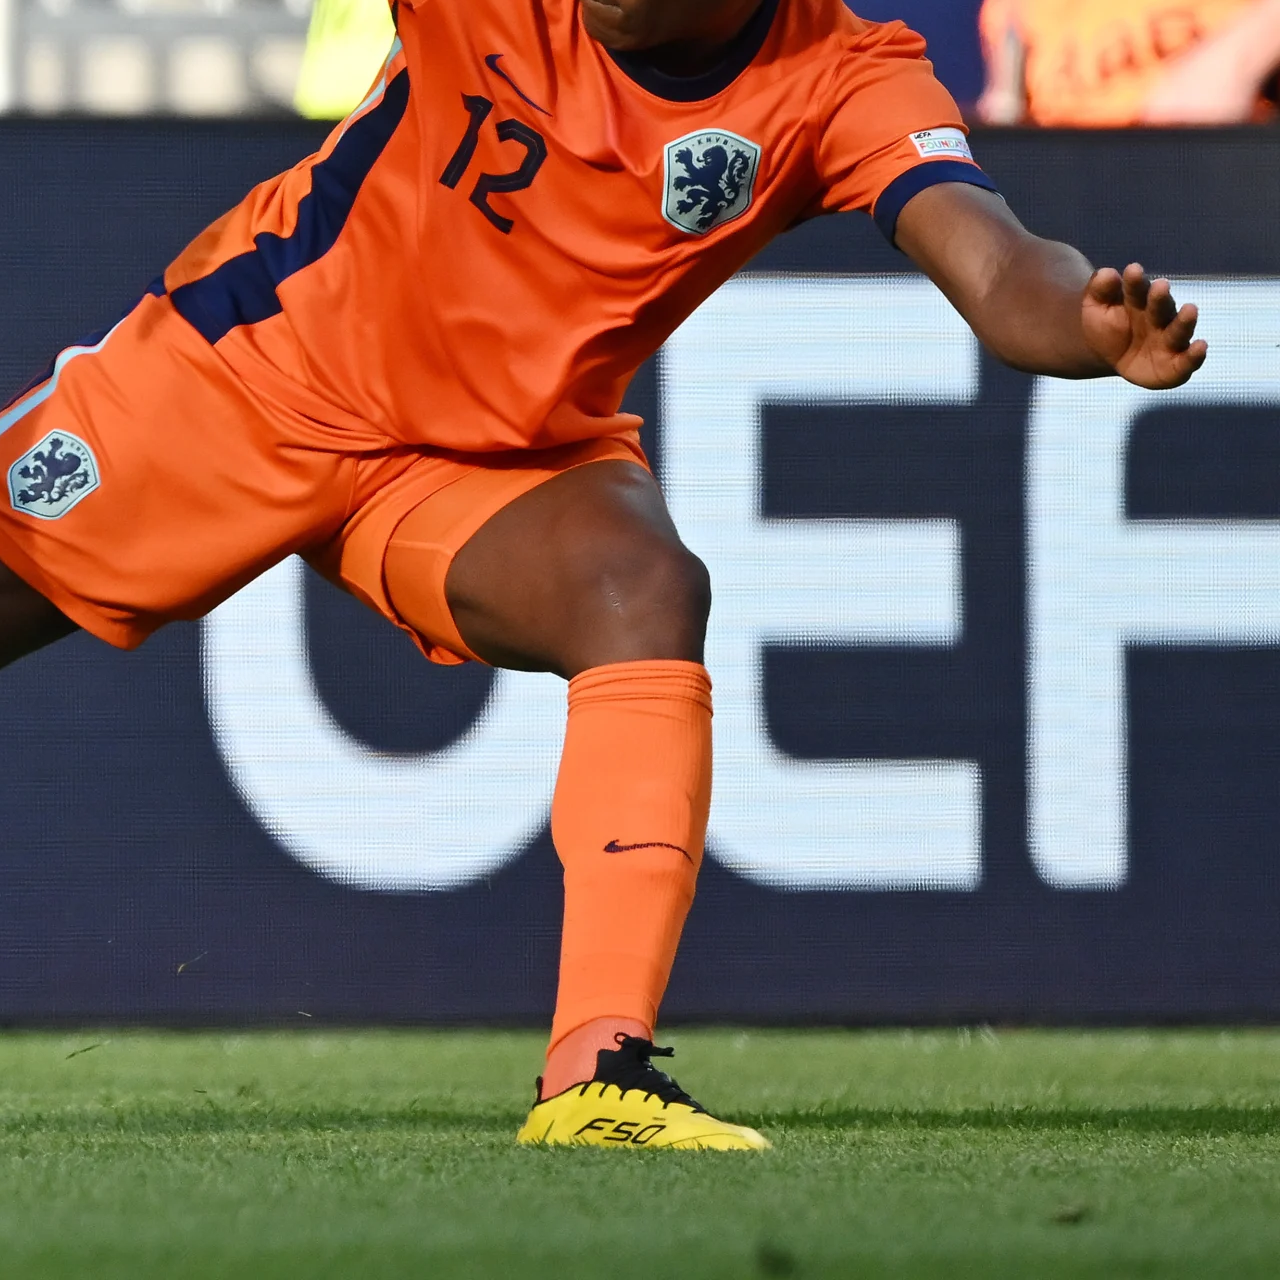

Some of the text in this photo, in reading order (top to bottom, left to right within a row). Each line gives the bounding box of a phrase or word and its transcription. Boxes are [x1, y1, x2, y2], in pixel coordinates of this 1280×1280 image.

[919, 139, 969, 152] FOUNDAT
[439, 92, 549, 234] 12
[575, 1118, 666, 1145] F50
